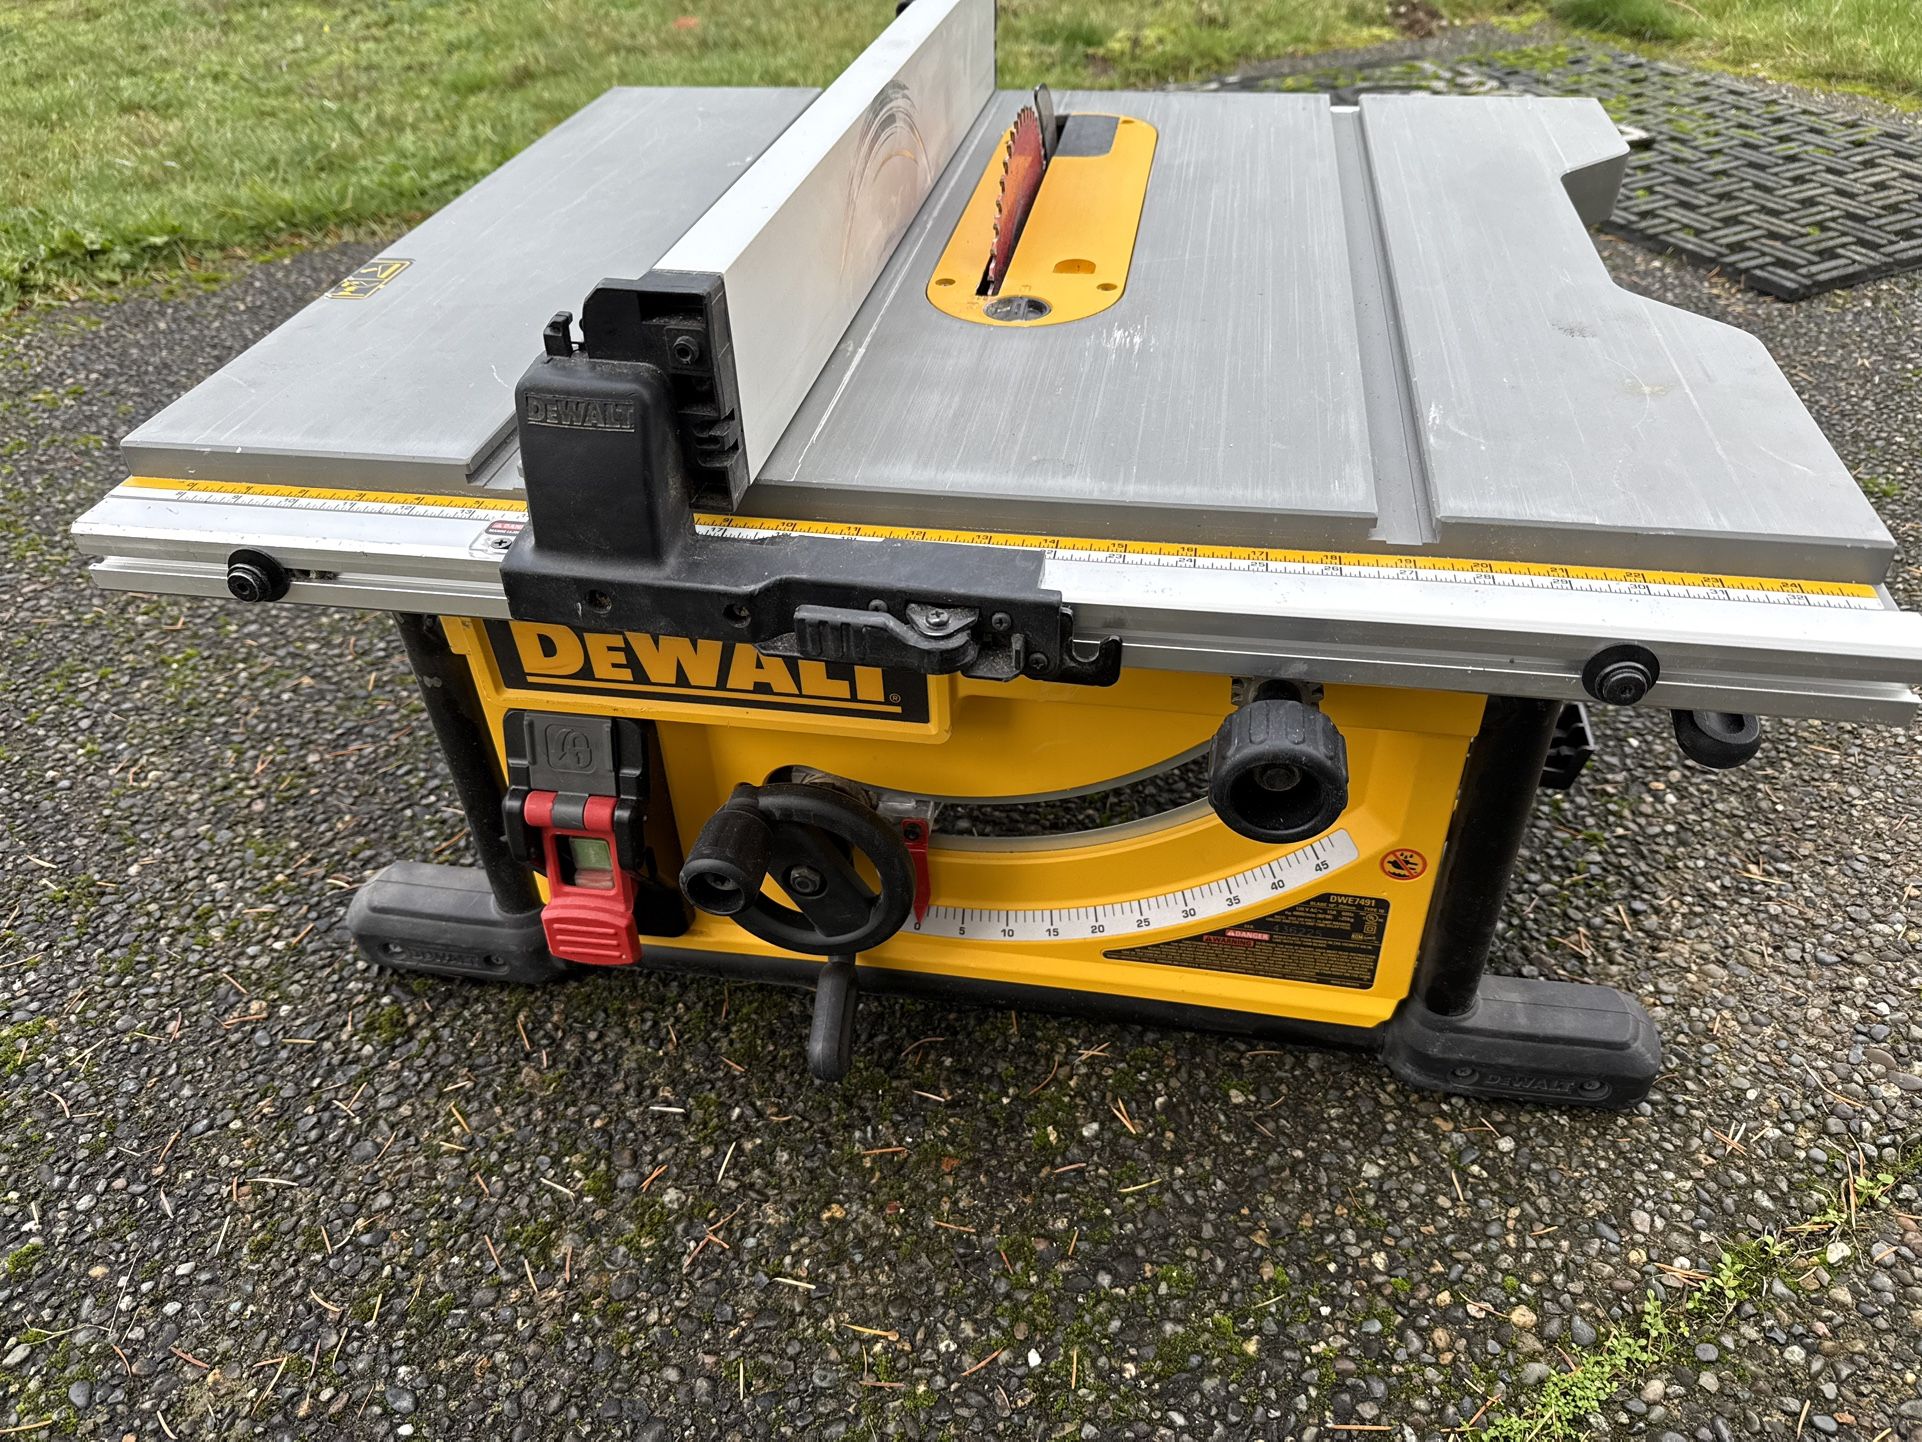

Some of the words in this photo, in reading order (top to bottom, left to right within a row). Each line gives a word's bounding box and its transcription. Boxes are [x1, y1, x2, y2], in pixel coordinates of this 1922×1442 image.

[527, 394, 634, 430] DEWALT
[914, 922, 920, 930] 0
[959, 926, 965, 935] 5
[1000, 929, 1014, 937] 10
[1045, 928, 1059, 936] 15
[1090, 924, 1105, 934] 20
[1136, 918, 1151, 928] 25
[1181, 908, 1196, 918] 30
[1226, 895, 1241, 907] 35
[1270, 879, 1285, 890] 40
[1314, 860, 1329, 872] 45
[1329, 895, 1376, 907] DWE7491
[1212, 936, 1253, 946] WARNING
[1234, 931, 1268, 940] DANGER
[1485, 1073, 1575, 1093] DEWALT
